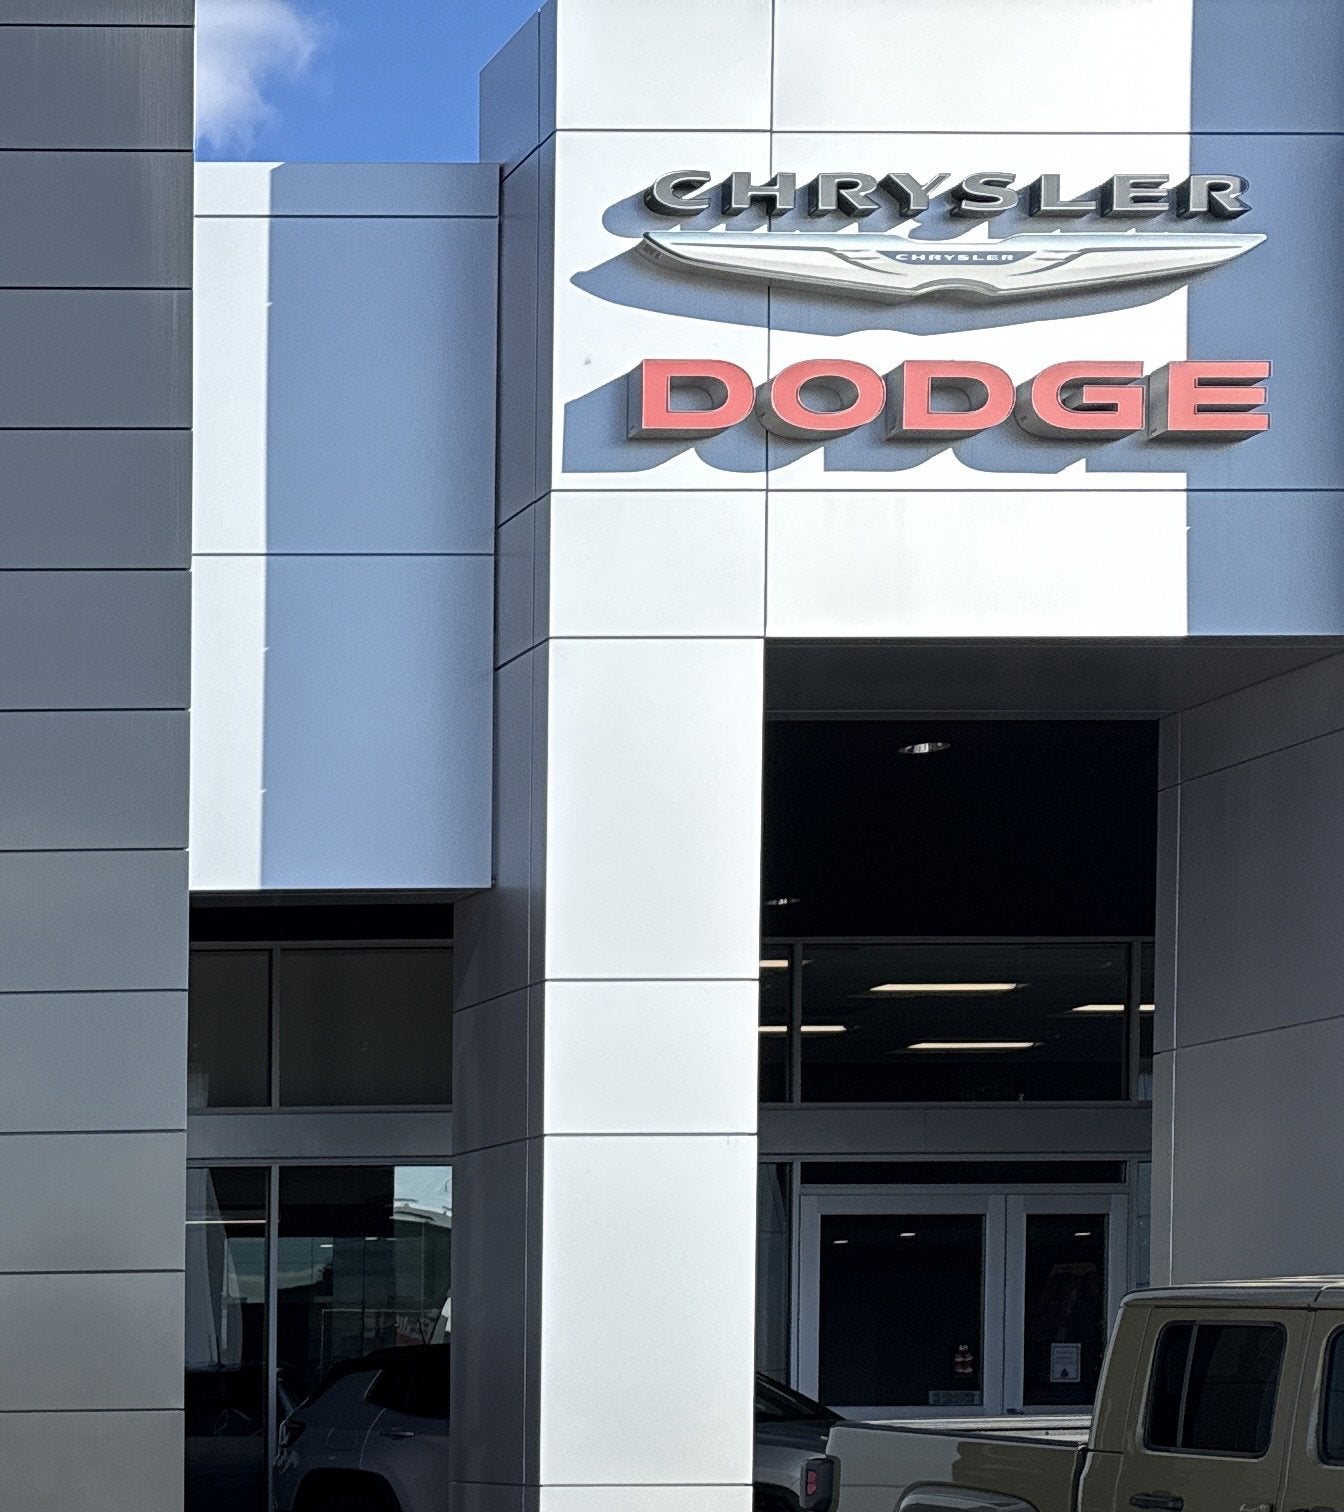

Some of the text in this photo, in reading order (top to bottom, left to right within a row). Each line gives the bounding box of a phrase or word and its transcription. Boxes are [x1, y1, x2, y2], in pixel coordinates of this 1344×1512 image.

[645, 170, 1252, 219] CHRYSLER
[895, 253, 1014, 261] CHRYSLER
[632, 358, 1272, 438] DODGE
